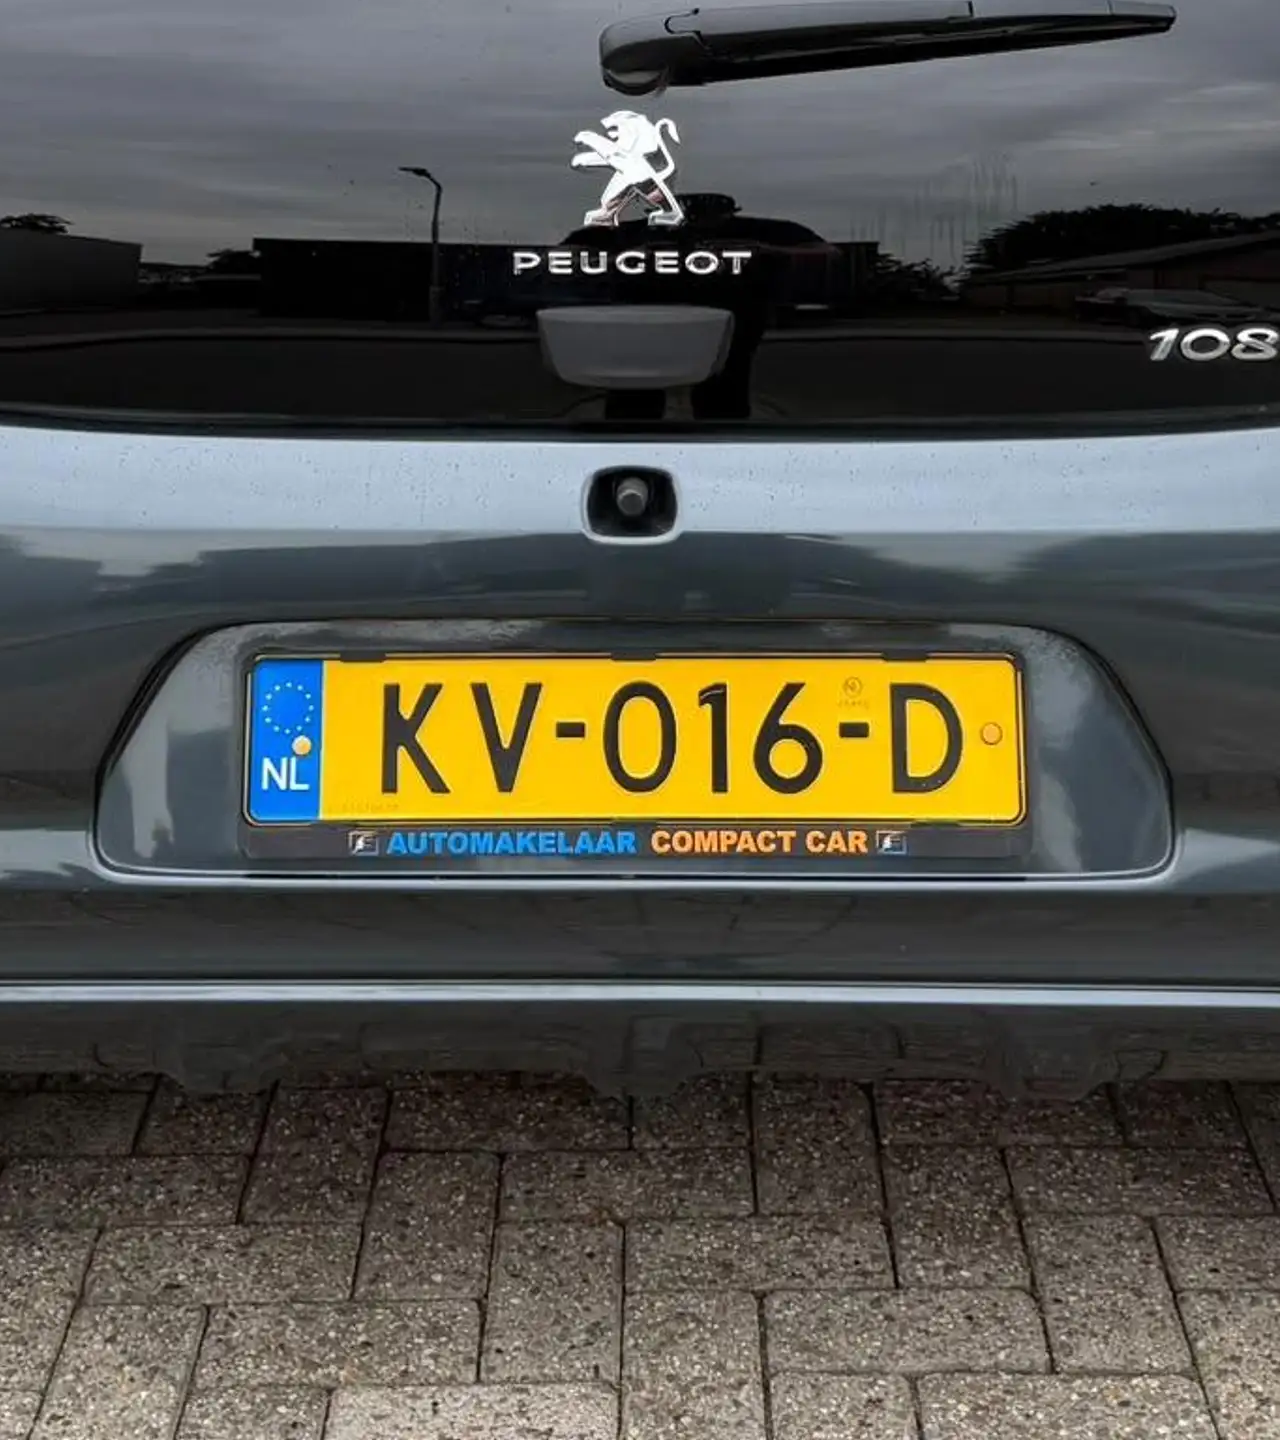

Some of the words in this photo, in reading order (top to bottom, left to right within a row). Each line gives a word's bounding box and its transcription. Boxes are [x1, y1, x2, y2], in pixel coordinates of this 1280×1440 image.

[513, 251, 752, 275] PEUGEOT
[1149, 328, 1280, 361] 108
[380, 681, 963, 794] KV-016-D
[261, 757, 309, 791] NL
[386, 831, 637, 854] AUTOMAKELAAR
[651, 830, 796, 854] COMPACT
[805, 830, 868, 854] CAR
